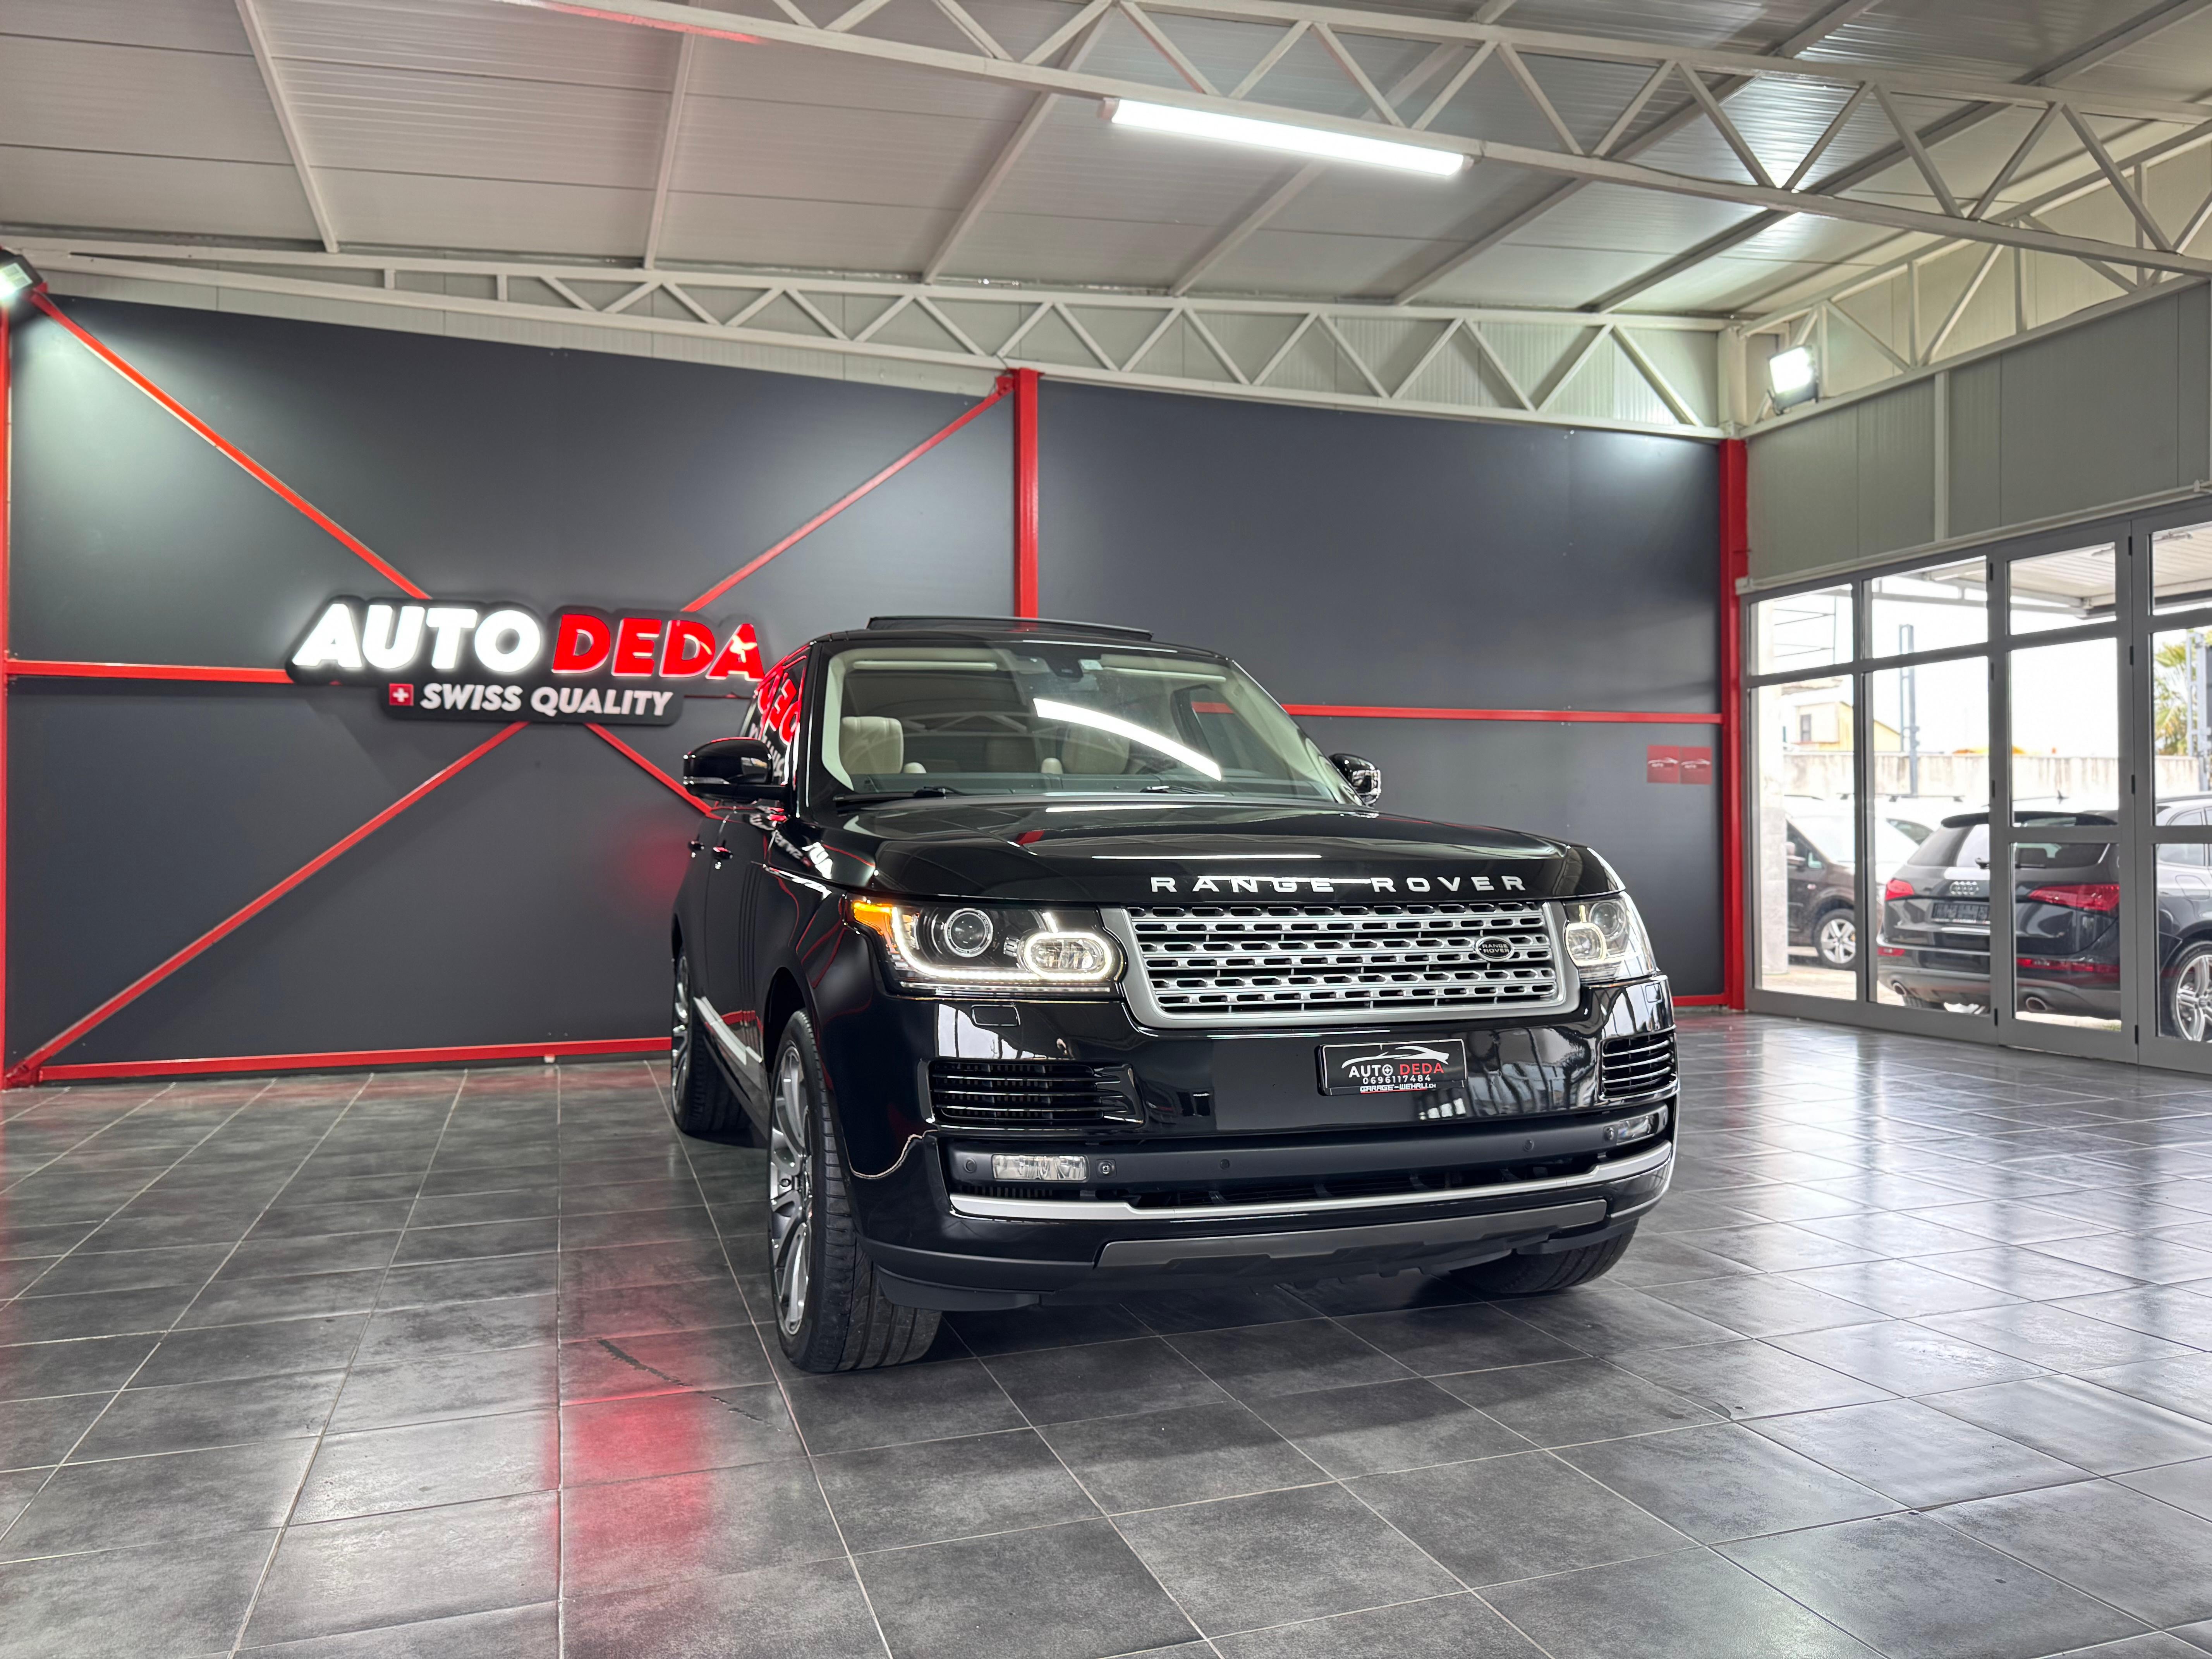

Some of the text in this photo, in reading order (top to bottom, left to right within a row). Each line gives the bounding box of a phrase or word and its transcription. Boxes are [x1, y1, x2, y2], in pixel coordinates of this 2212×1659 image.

[292, 603, 765, 682] AUTO DEDA
[420, 682, 674, 716] SWISS QUALITY
[1151, 876, 1526, 893] RANGE ROVER
[1349, 1063, 1444, 1078] AUTO DEDA
[1363, 1075, 1431, 1084] 0696117484
